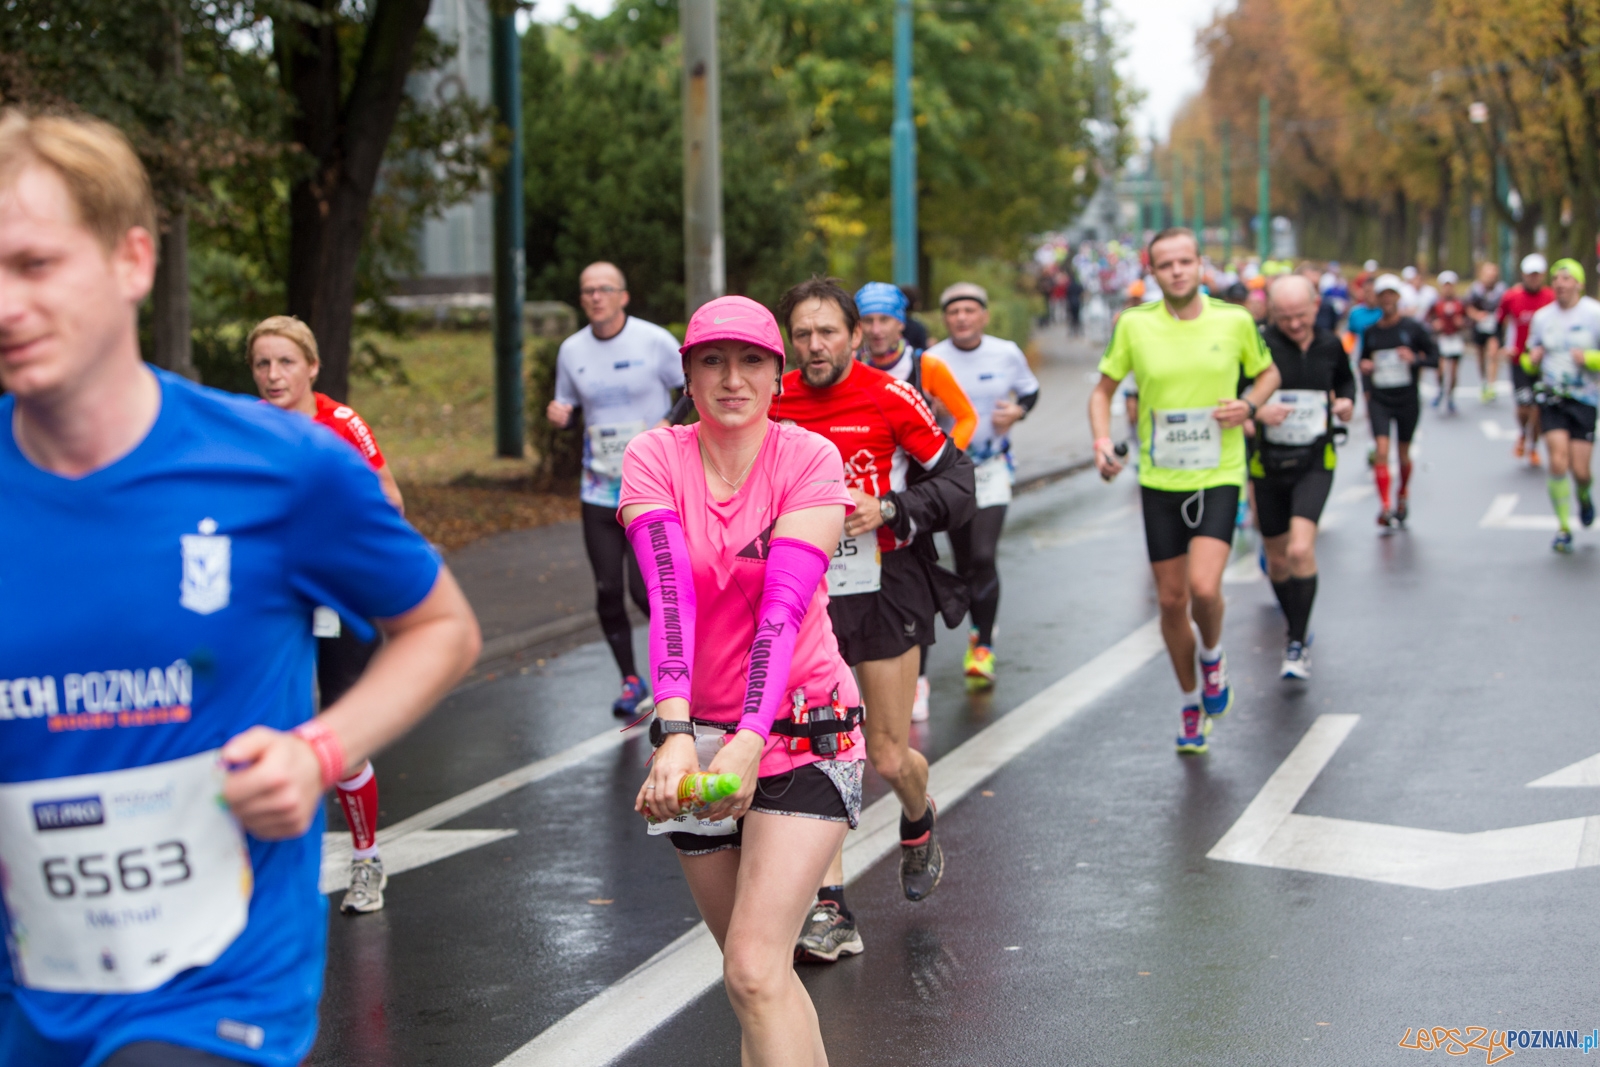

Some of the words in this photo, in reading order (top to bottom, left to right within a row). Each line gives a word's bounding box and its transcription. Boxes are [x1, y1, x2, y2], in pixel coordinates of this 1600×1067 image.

[1165, 428, 1211, 443] 4844
[648, 520, 670, 552] JEDNA
[655, 551, 676, 583] TYLKO
[661, 584, 678, 606] JEST
[661, 606, 684, 658] KRÓLOWA
[63, 658, 193, 715] POZNAŃ
[742, 638, 772, 716] HONORATA
[41, 839, 193, 899] 6563
